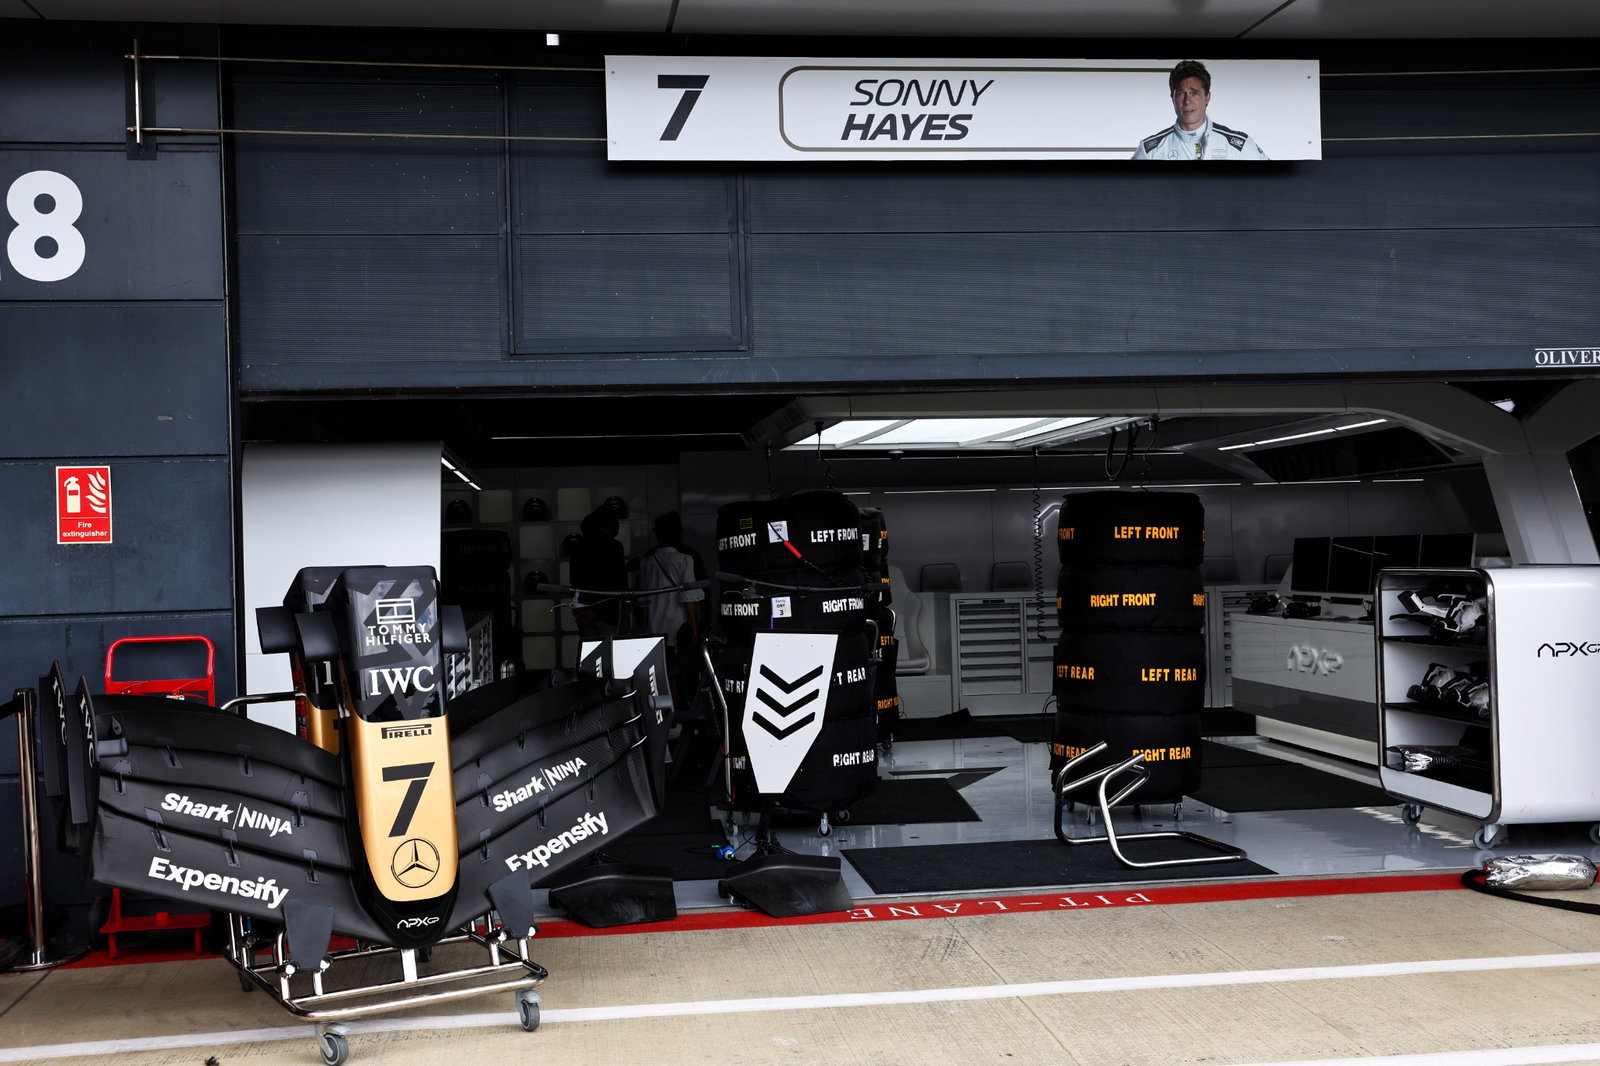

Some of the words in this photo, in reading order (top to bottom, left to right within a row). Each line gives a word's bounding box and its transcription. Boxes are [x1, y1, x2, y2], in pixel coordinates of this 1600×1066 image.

[849, 79, 994, 106] SONNY
[657, 74, 710, 141] 7
[841, 113, 973, 141] HAYES
[77, 521, 93, 529] Fire
[1114, 526, 1142, 539] LEFT
[1145, 526, 1180, 539] FRONT
[62, 530, 108, 538] extinguisher
[729, 532, 757, 549] FRONT
[811, 529, 835, 543] LEFT
[837, 527, 858, 541] FRONT
[822, 598, 848, 614] RIGHT
[1090, 594, 1119, 607] RIGHT
[1122, 593, 1156, 606] FRONT
[734, 602, 760, 616] FRONT
[367, 622, 427, 636] TOMMY
[366, 633, 432, 646] HILFIGER
[368, 665, 436, 696] IWC
[847, 667, 866, 685] REAR
[1070, 665, 1095, 680] REAR
[1141, 668, 1170, 682] LEFT
[1174, 667, 1197, 681] REAR
[877, 698, 893, 711] RIGHT
[381, 723, 432, 739] PIRELLI
[832, 752, 861, 767] RIGHT
[861, 749, 875, 764] REAR
[1169, 746, 1191, 760] REAR
[492, 775, 546, 813] Shark
[545, 757, 587, 787] NINJA
[382, 761, 435, 838] 7
[161, 793, 234, 823] Shark
[238, 807, 292, 837] NINJA
[505, 811, 609, 872] Expensify
[148, 856, 289, 909] Expensify
[847, 892, 1154, 920] PIT-LANE
